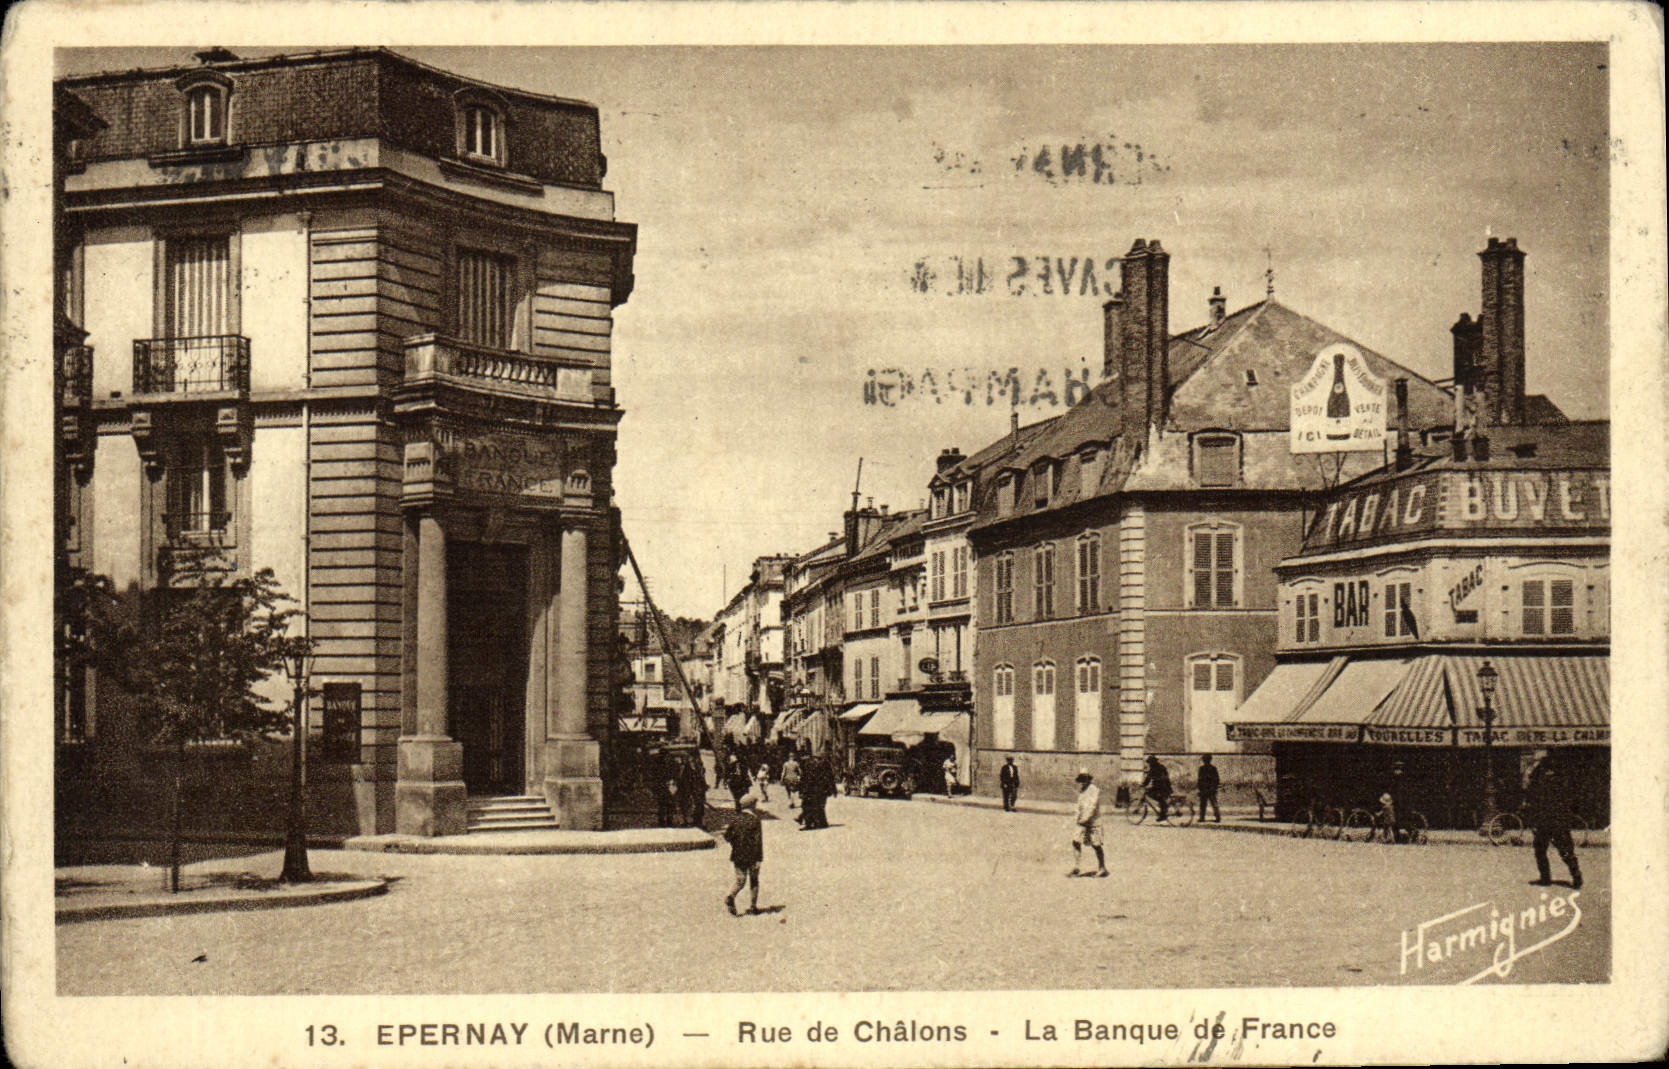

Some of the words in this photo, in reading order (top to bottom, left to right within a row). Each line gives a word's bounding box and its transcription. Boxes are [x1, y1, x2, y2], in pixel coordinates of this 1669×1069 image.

[1297, 431, 1322, 442] ICI
[1323, 484, 1426, 540] TABAC
[1448, 564, 1484, 607] TABAC
[1333, 580, 1370, 628] BAR
[1371, 729, 1444, 743] TOURELLES
[1464, 731, 1509, 743] TAAC
